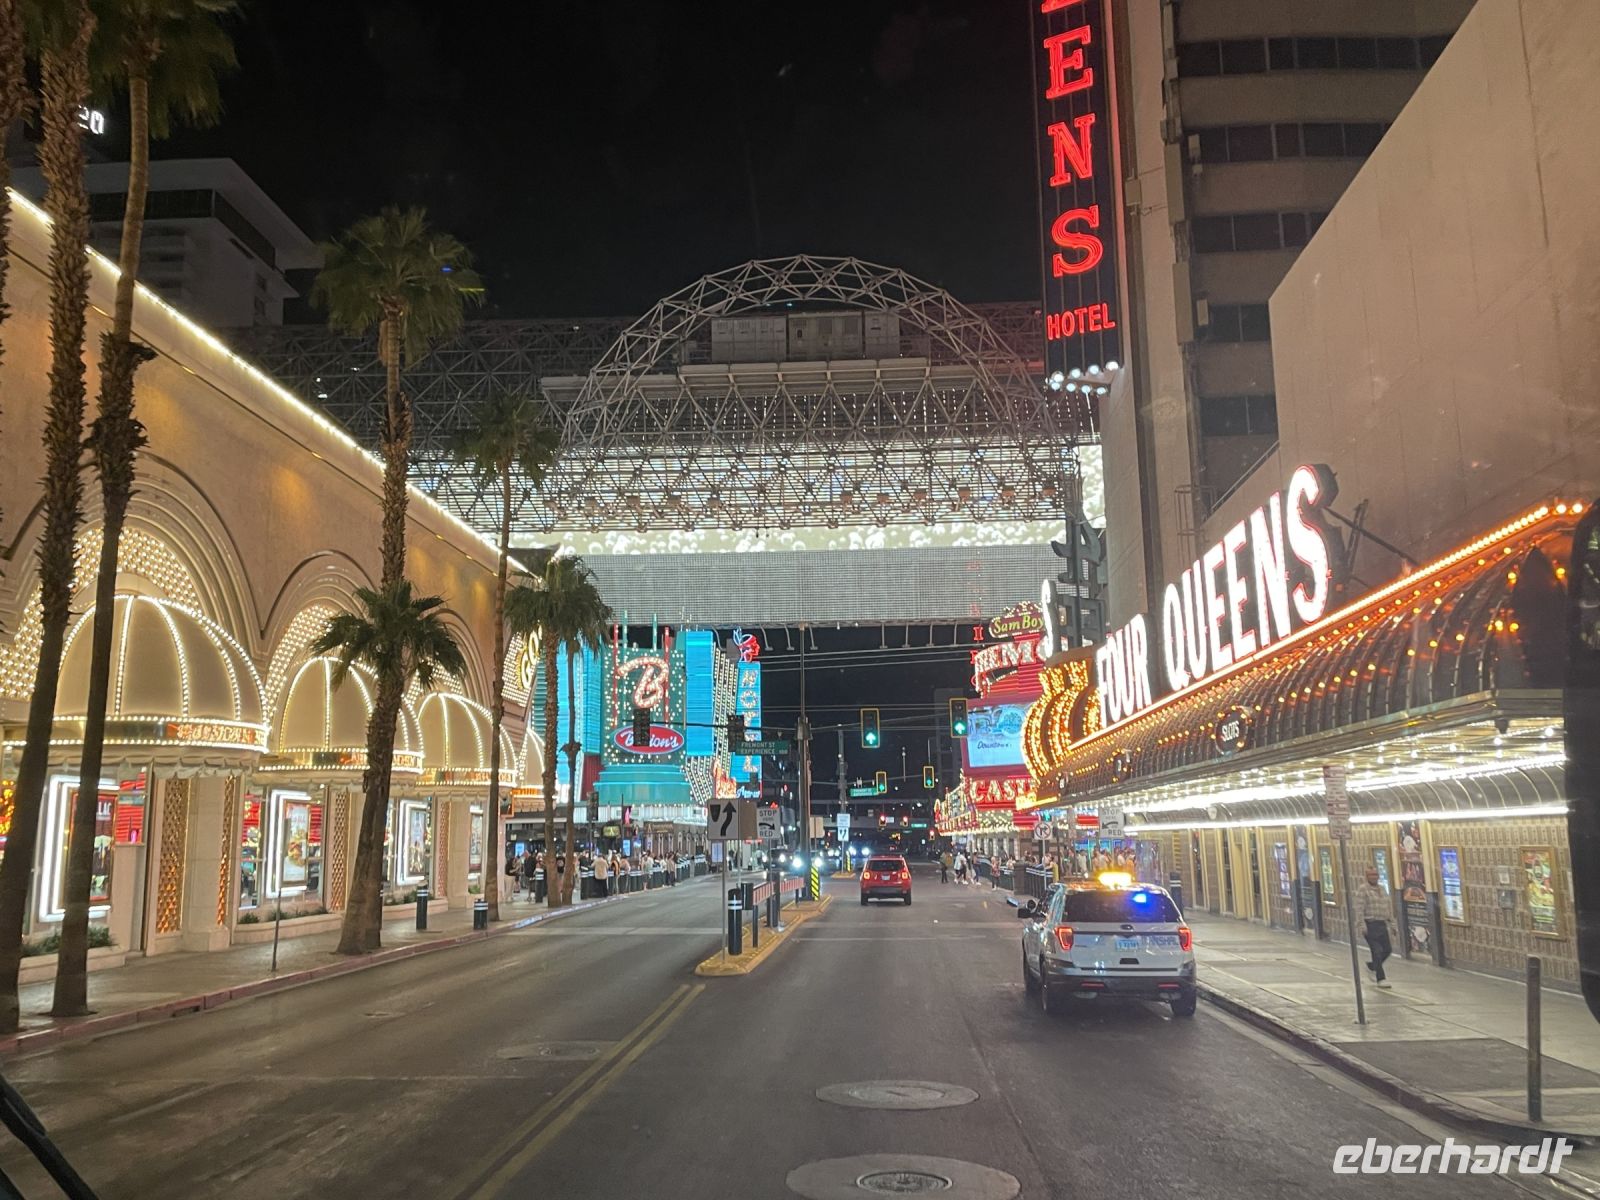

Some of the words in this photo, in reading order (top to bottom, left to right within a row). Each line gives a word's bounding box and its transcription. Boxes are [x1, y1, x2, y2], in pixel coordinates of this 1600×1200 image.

[1041, 0, 1103, 277] ENS
[1047, 303, 1116, 340] HOTEL
[1097, 613, 1152, 728] FOUR
[1163, 464, 1329, 692] QUEENS
[993, 618, 1020, 634] Sam
[616, 655, 669, 709] B
[620, 730, 679, 748] Bion's
[1221, 720, 1240, 742] SLOTS
